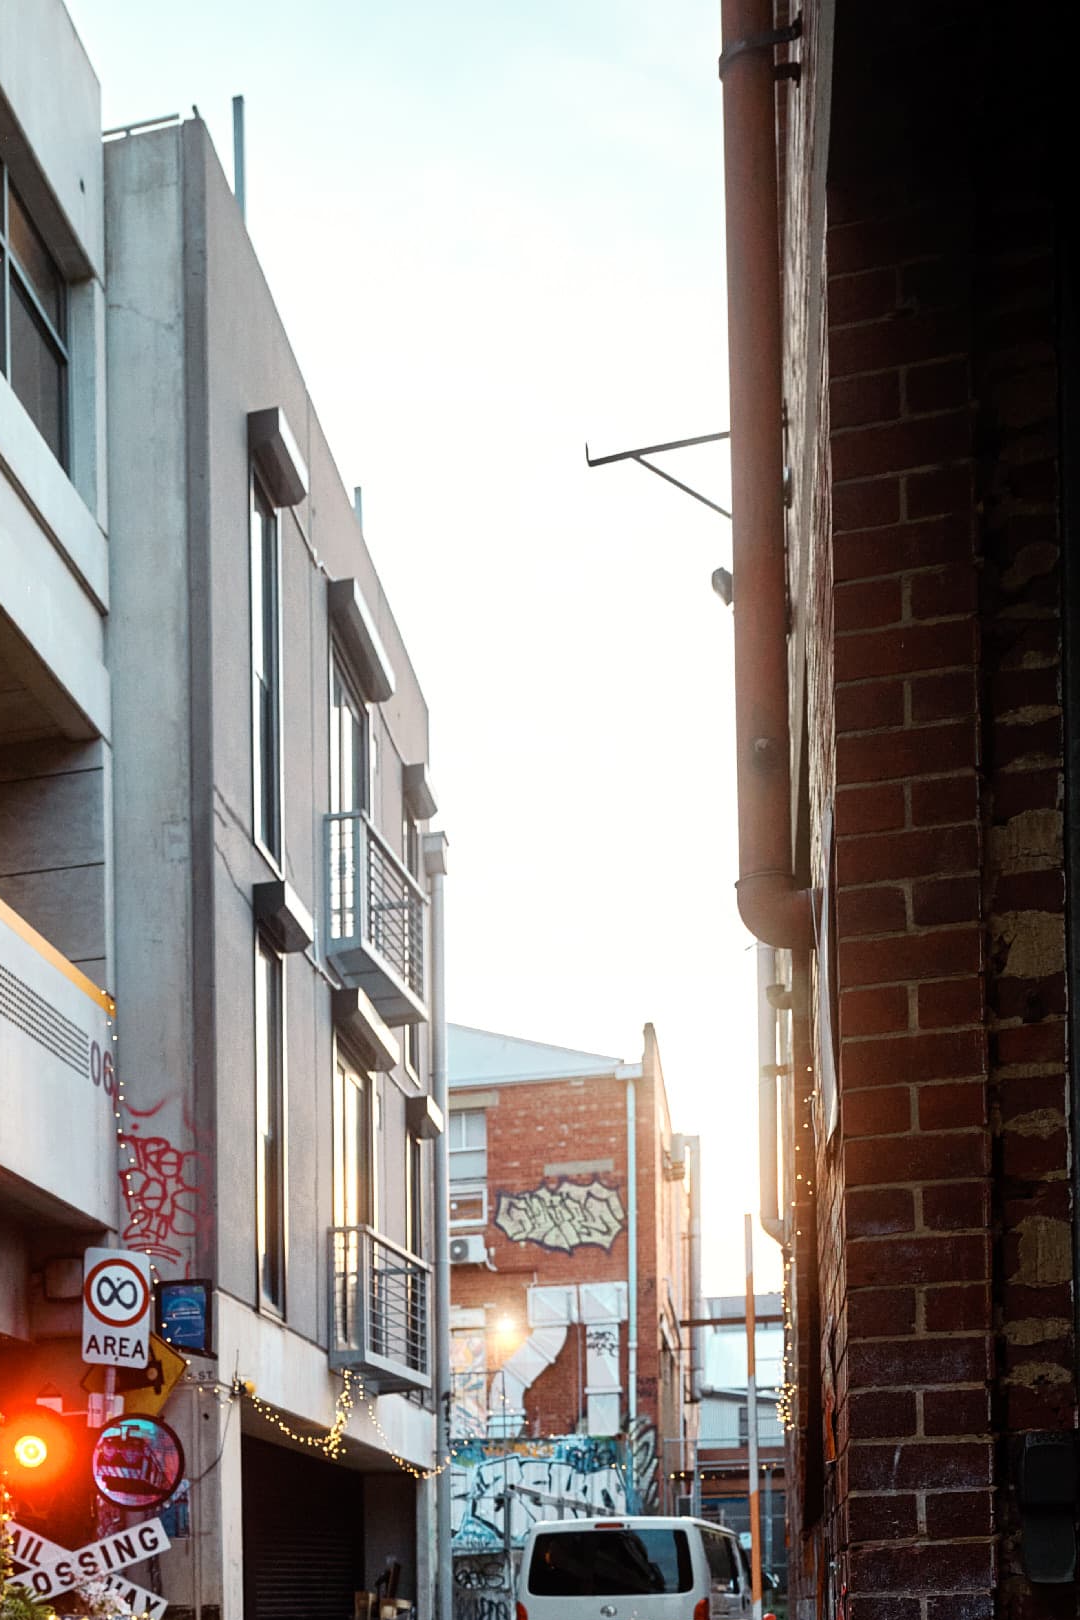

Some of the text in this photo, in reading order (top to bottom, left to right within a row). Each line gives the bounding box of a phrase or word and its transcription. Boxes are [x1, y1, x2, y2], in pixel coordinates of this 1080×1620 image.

[91, 1040, 113, 1096] 06
[85, 1334, 145, 1360] AREA
[10, 1529, 44, 1567] AIL
[11, 1526, 160, 1596] OSSING
